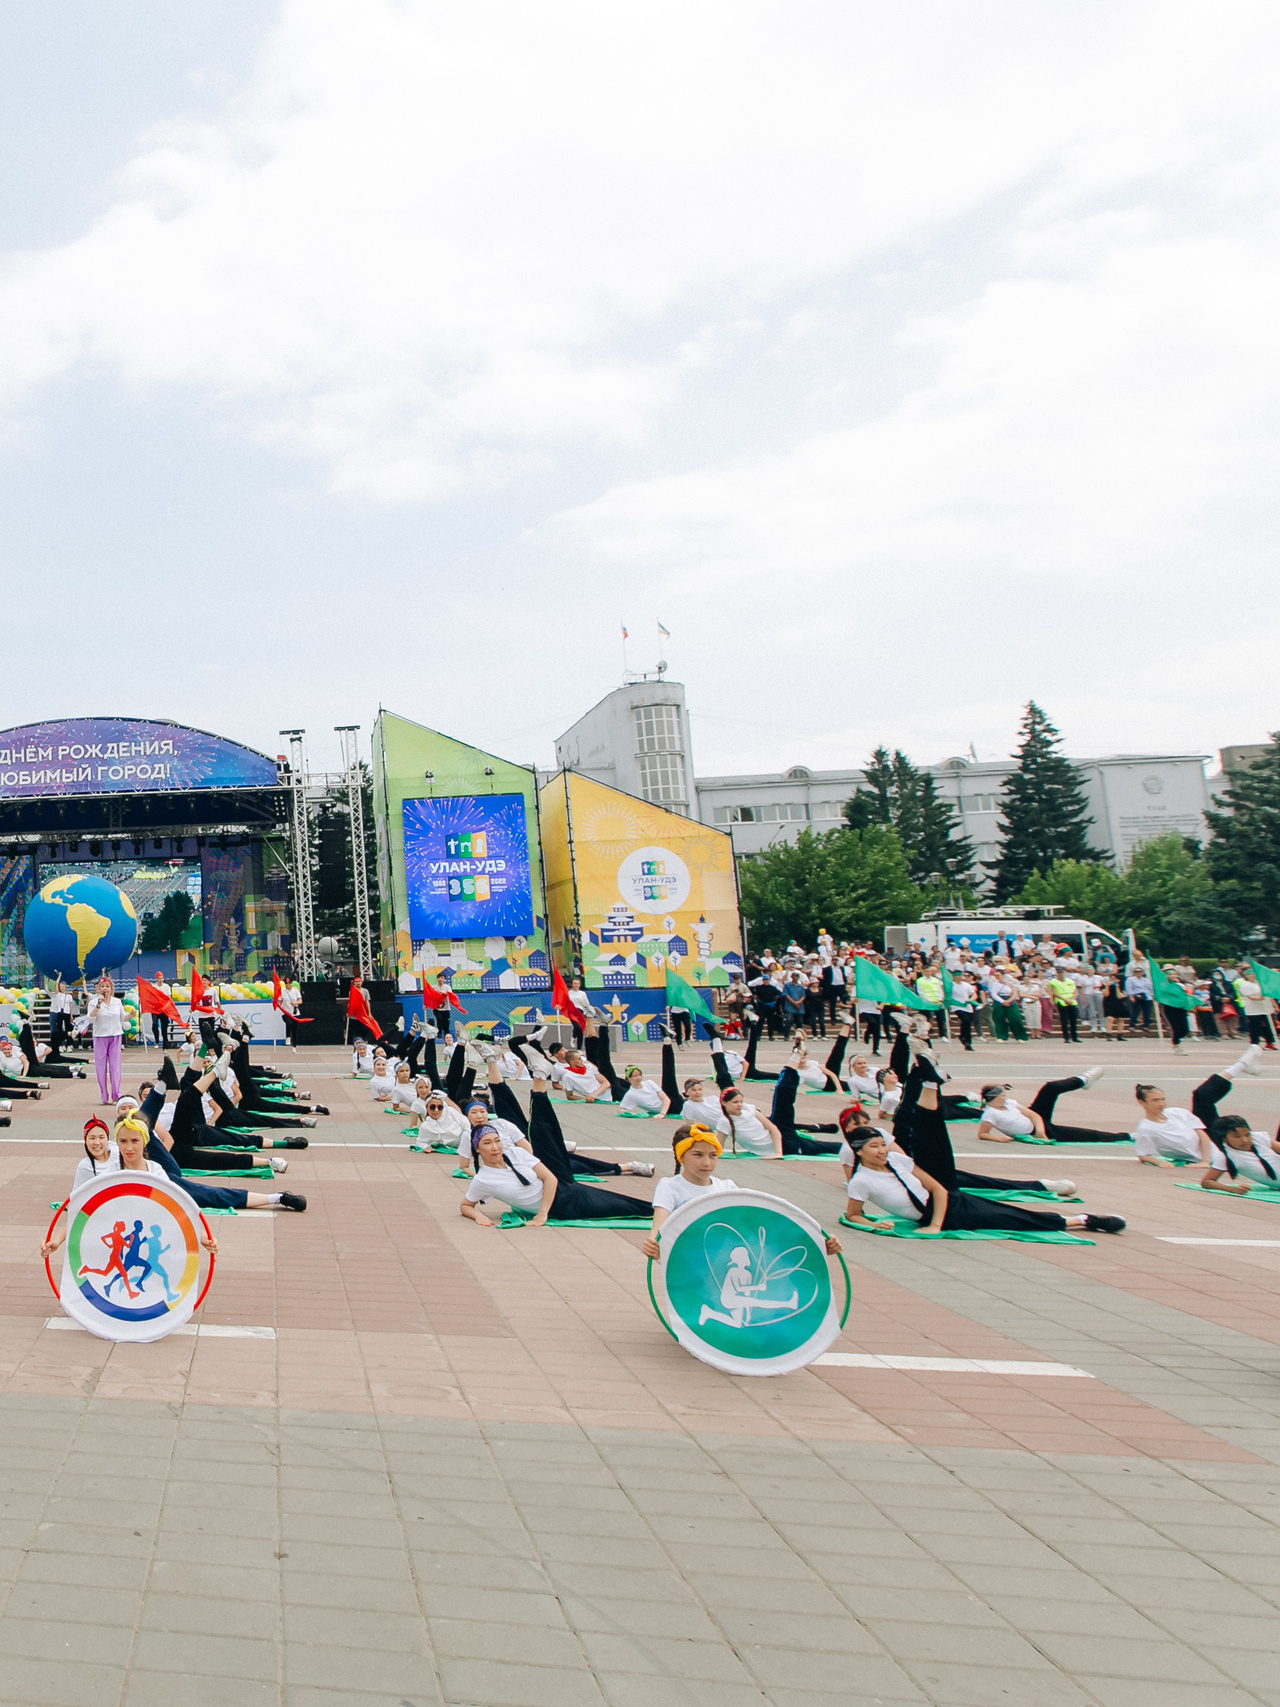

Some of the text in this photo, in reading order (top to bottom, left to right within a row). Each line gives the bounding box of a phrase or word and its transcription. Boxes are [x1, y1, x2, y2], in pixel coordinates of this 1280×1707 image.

[58, 740, 179, 761] РОЖДЕНИЯ,
[97, 763, 171, 781] ГОРОД!
[429, 859, 506, 874] УЛАН-УДЭ
[631, 876, 677, 885] УЛАН-УДЭ
